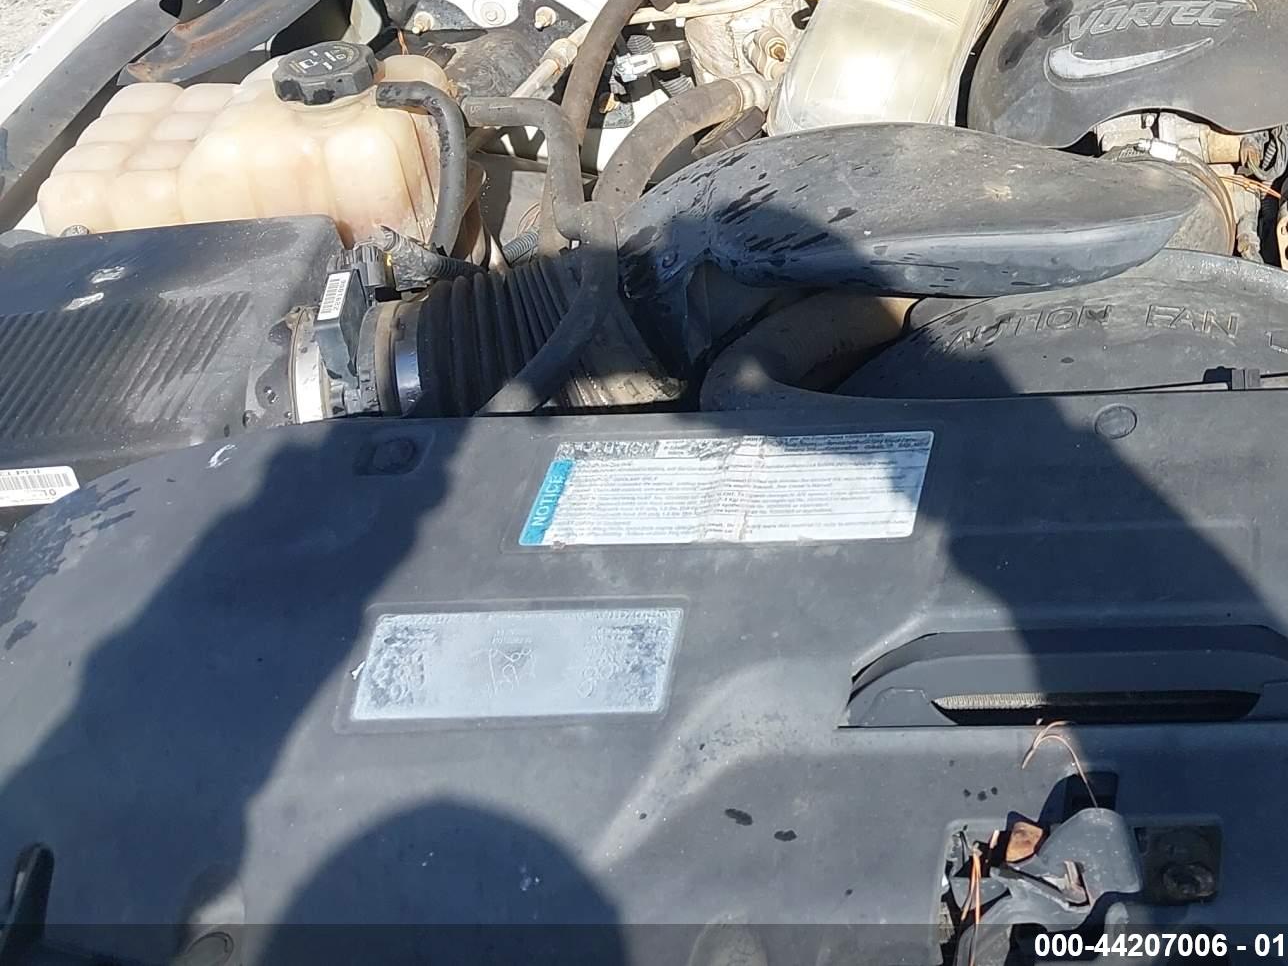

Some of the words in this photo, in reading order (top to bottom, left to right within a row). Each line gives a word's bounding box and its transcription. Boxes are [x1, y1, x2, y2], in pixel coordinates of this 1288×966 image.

[1063, 0, 1242, 41] VORTEC
[1145, 304, 1240, 339] FAN
[531, 474, 566, 527] NOTICE
